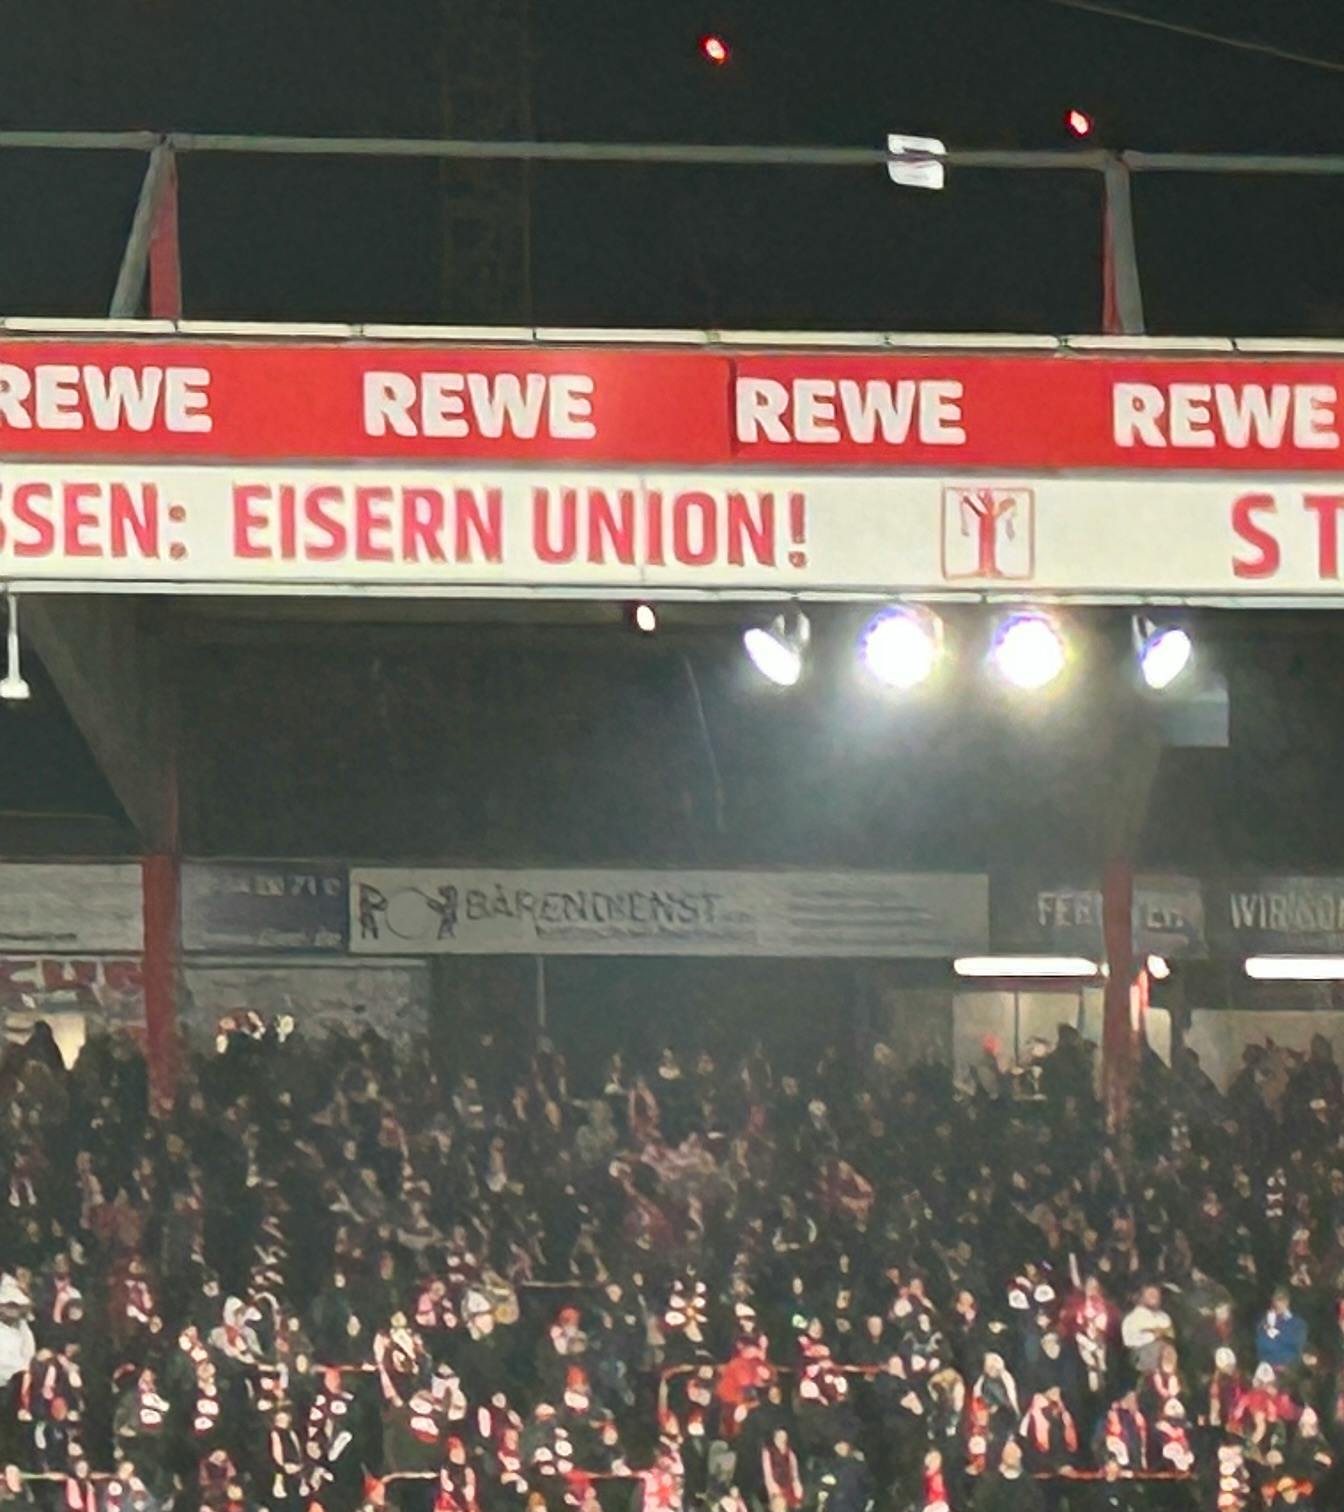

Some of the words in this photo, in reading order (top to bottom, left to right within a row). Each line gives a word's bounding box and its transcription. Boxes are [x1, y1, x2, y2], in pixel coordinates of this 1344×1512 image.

[0, 363, 212, 433] REWE
[363, 371, 597, 440] REWE
[736, 376, 966, 446] REWE
[1113, 381, 1340, 450] REWE
[0, 482, 188, 561] SEN:
[232, 484, 504, 565] EISERN
[532, 486, 807, 570] UNION!
